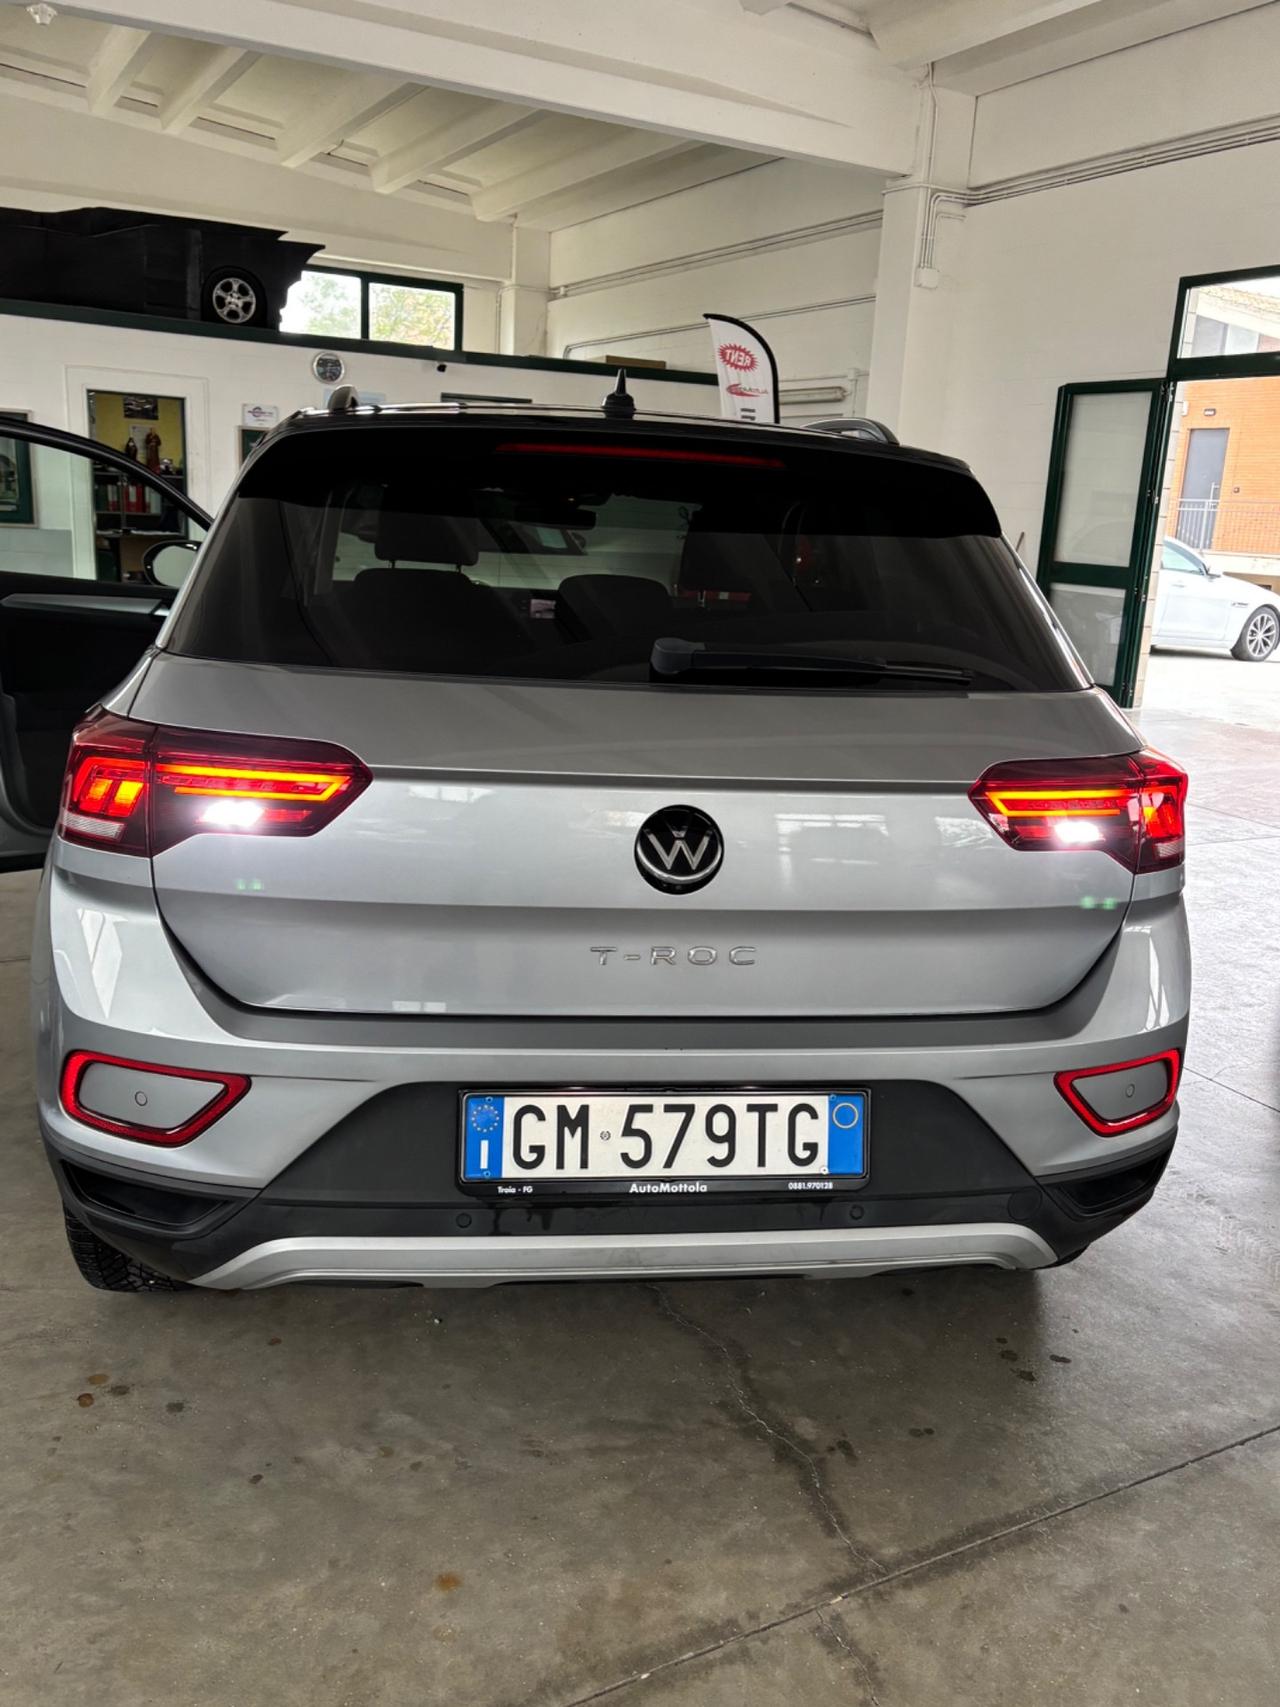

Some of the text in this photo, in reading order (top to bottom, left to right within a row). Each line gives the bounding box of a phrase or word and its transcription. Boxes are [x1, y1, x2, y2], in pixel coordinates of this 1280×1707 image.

[590, 945, 757, 966] T-ROC
[512, 1103, 819, 1170] GM 579TG
[629, 1181, 708, 1193] AutoMottola
